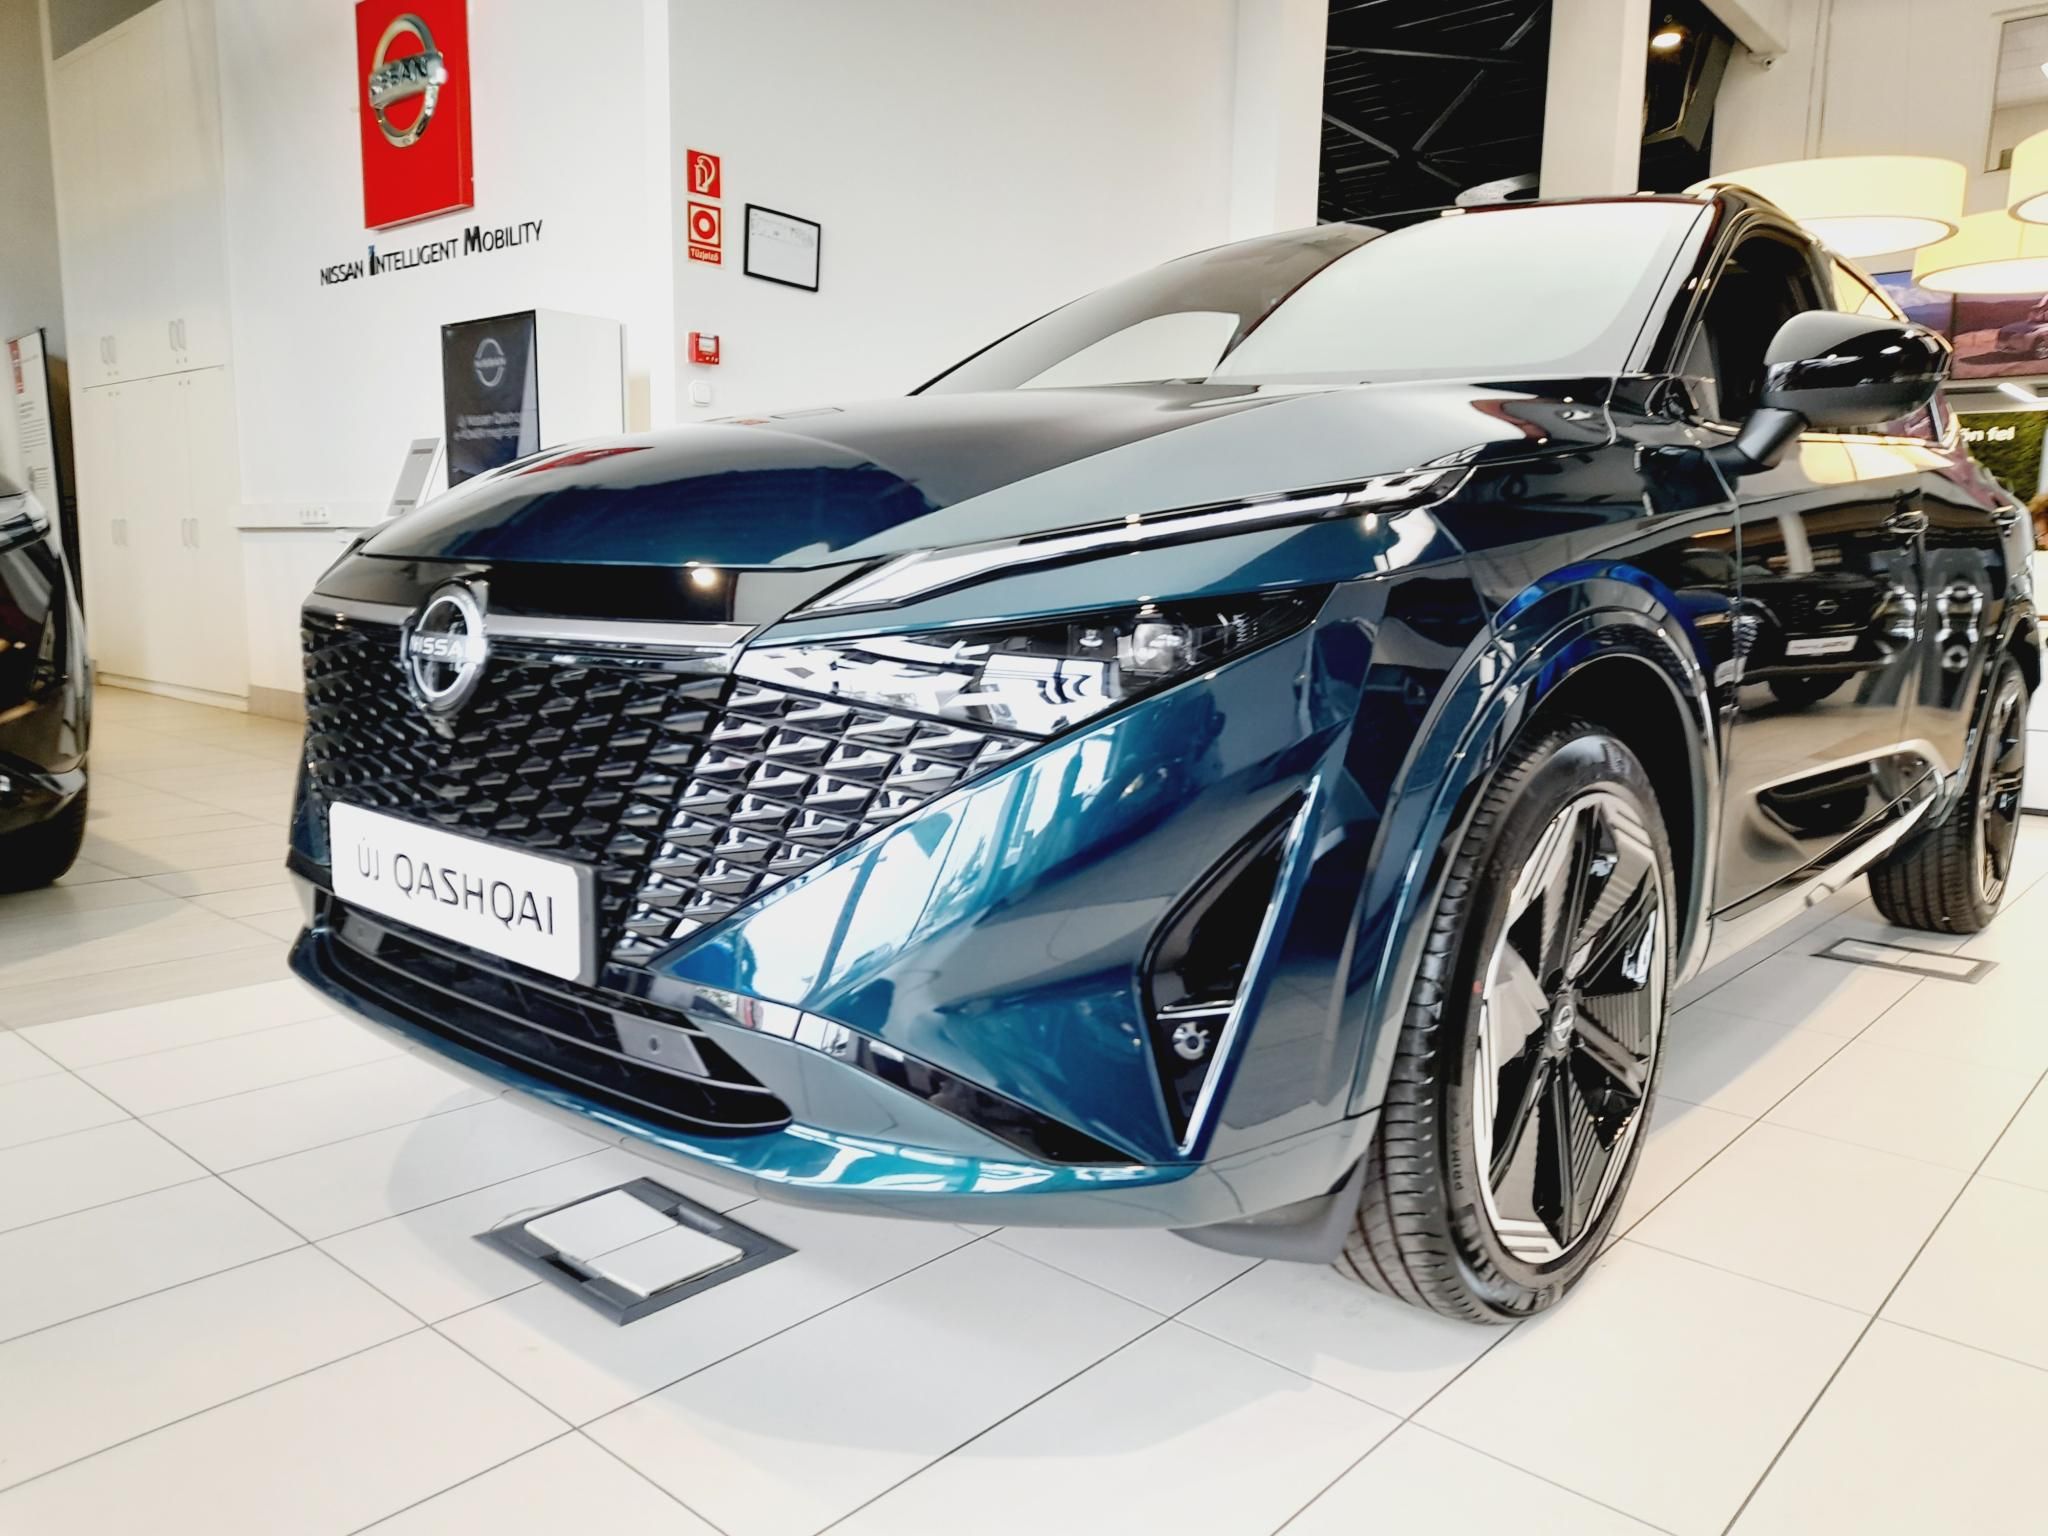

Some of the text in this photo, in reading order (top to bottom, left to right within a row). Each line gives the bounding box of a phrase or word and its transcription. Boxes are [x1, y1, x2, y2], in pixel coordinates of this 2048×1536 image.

[320, 219, 543, 286] NISSAN INTELLIGENT MOBILITY
[409, 634, 477, 659] NISSA
[357, 836, 554, 936] ÚJ QASHQAI
